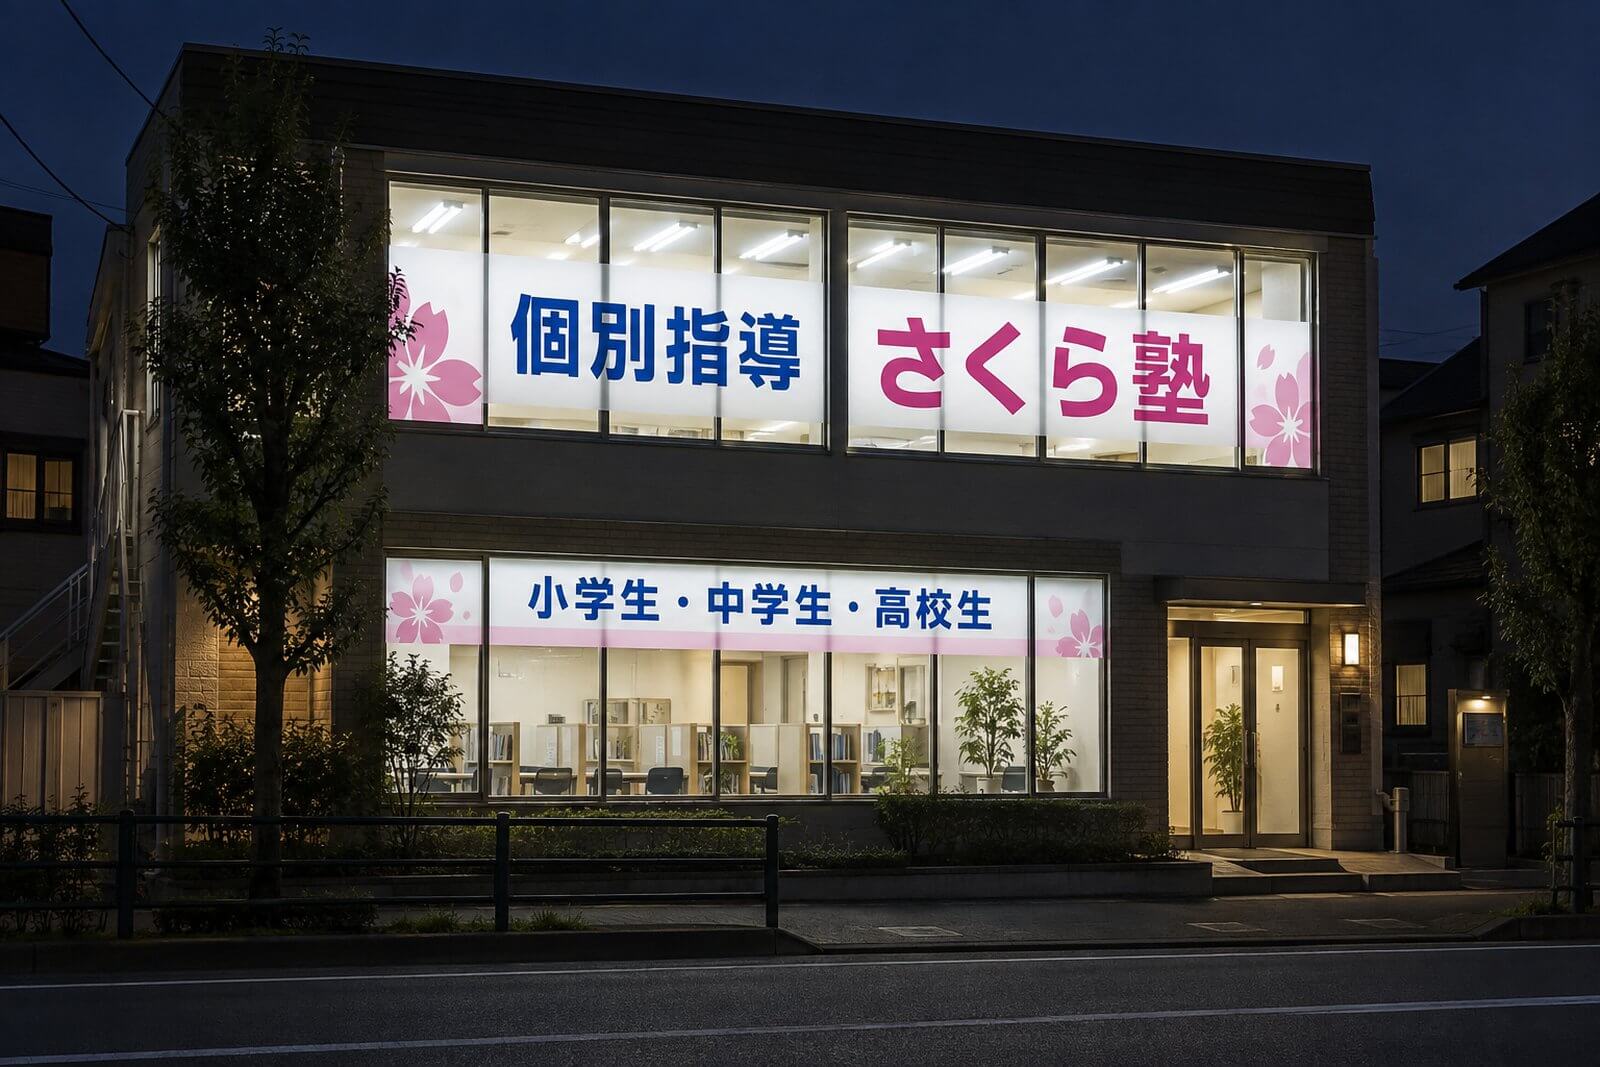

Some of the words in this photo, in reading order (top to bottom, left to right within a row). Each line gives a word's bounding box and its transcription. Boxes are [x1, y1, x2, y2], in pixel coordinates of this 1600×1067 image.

[510, 293, 801, 391] 個別指導
[877, 317, 1210, 425] さくら塾
[528, 575, 993, 630] 小学生・中学生・高校生
